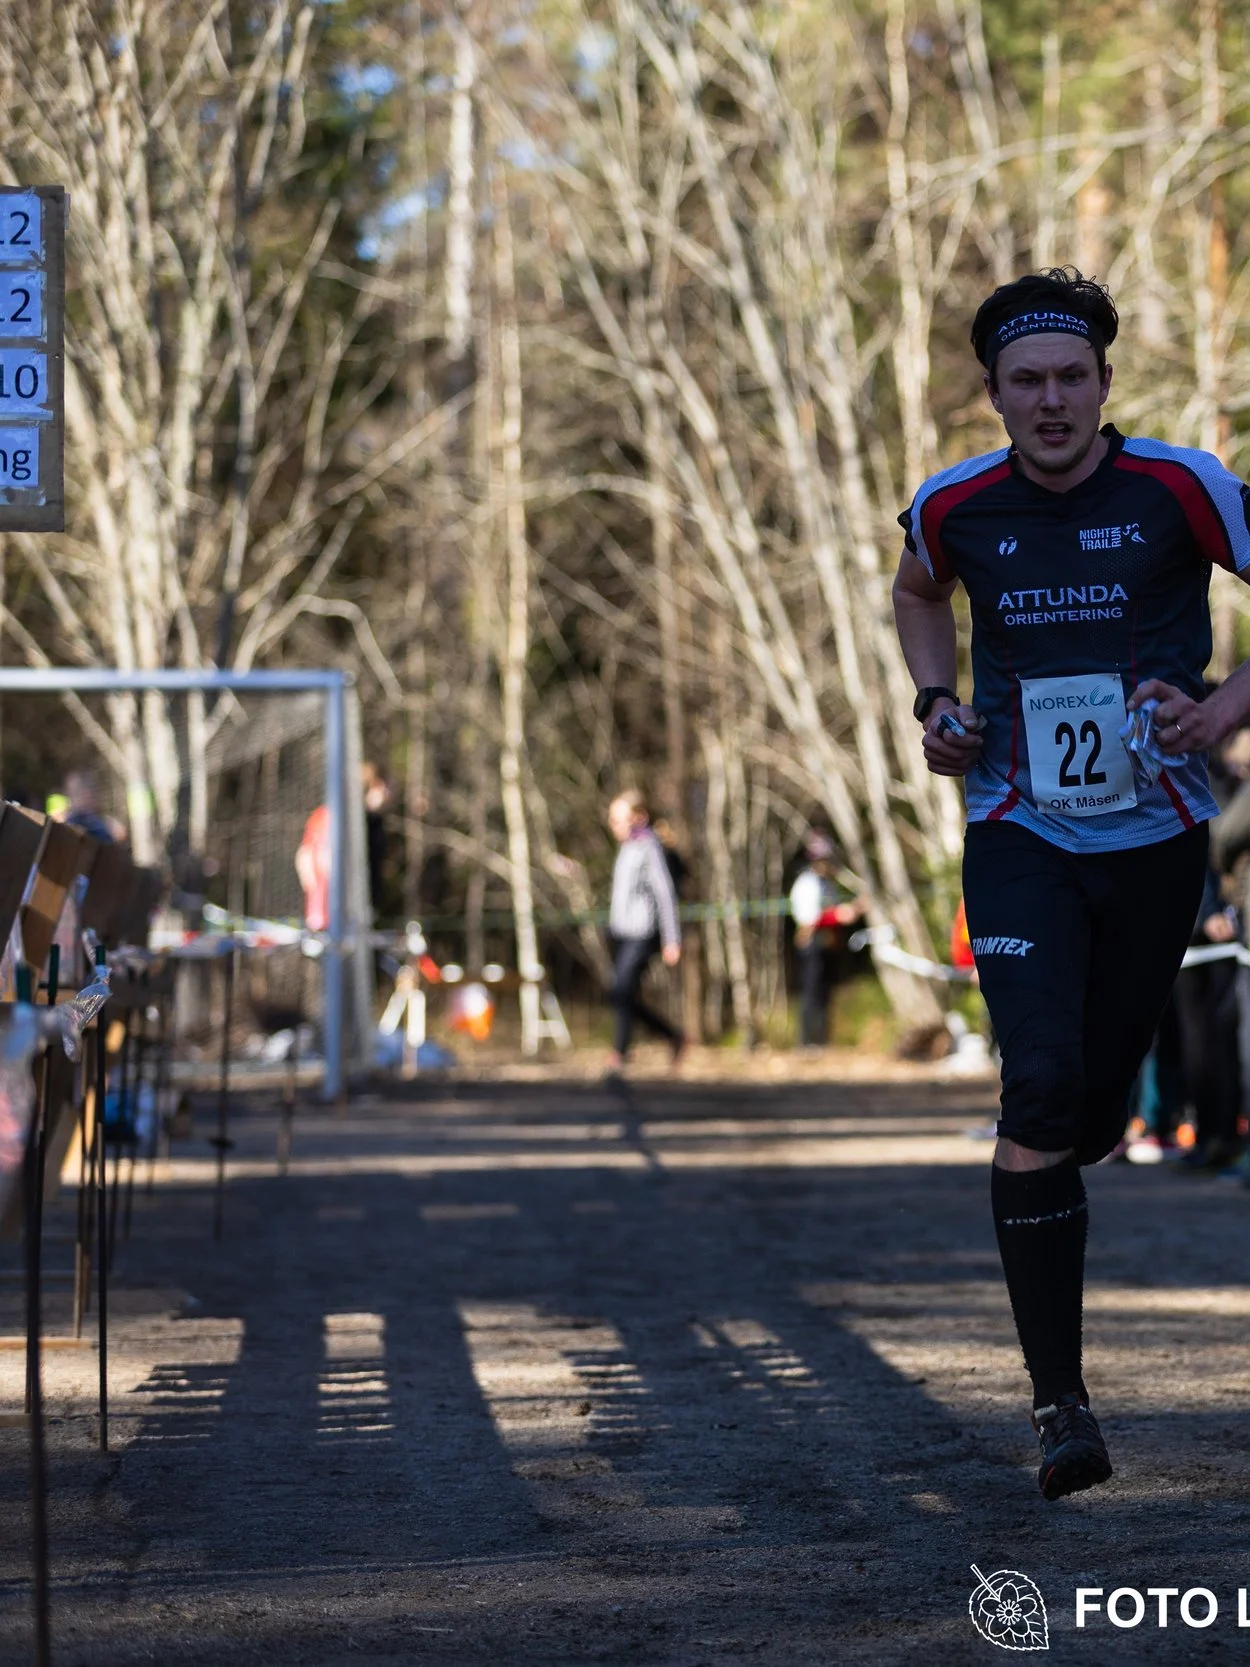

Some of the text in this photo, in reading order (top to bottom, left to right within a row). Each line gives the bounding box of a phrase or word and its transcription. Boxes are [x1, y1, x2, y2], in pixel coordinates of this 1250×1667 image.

[0, 211, 32, 246] 2
[0, 288, 33, 323] 2
[998, 312, 1089, 335] ATTUNDA
[1000, 322, 1089, 342] ORIENTERING
[1079, 527, 1111, 540] NIGHT
[1111, 526, 1122, 548] RUN
[1080, 538, 1112, 551] TRAIL
[998, 583, 1129, 610] ATTUNDA
[1004, 607, 1123, 626] ORIENTERING
[1029, 695, 1089, 712] NOREX
[1055, 719, 1107, 788] 22
[1050, 793, 1121, 811] OK Måsen
[972, 936, 1035, 957] TRIMTEX
